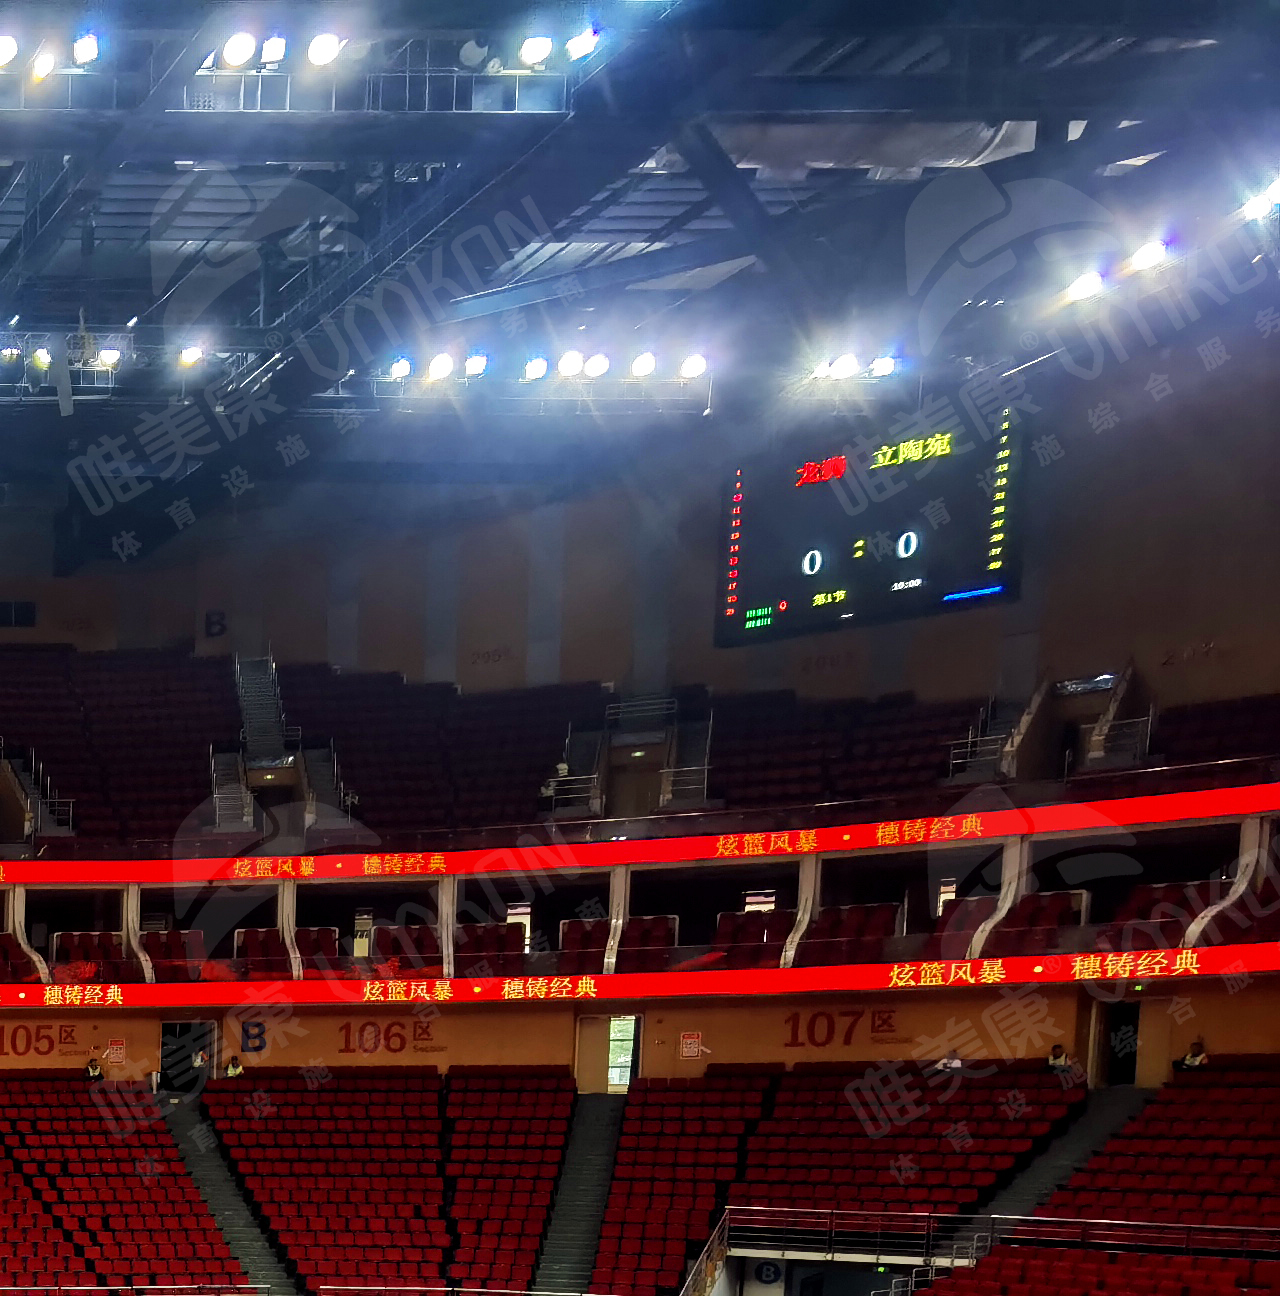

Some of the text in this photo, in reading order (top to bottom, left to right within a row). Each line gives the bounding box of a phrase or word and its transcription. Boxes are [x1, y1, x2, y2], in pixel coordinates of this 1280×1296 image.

[870, 433, 951, 469] 立陶宛
[802, 531, 918, 576] 0 0
[205, 609, 227, 637] B
[889, 950, 1200, 986] 炫篮风暴 穗铸经典
[45, 984, 123, 1005] 穗铸经典
[362, 976, 597, 1000] 炫篮风暴 穗铸经典
[241, 1021, 267, 1054] B
[338, 1020, 433, 1053] 106区
[785, 1010, 896, 1048] 107区
